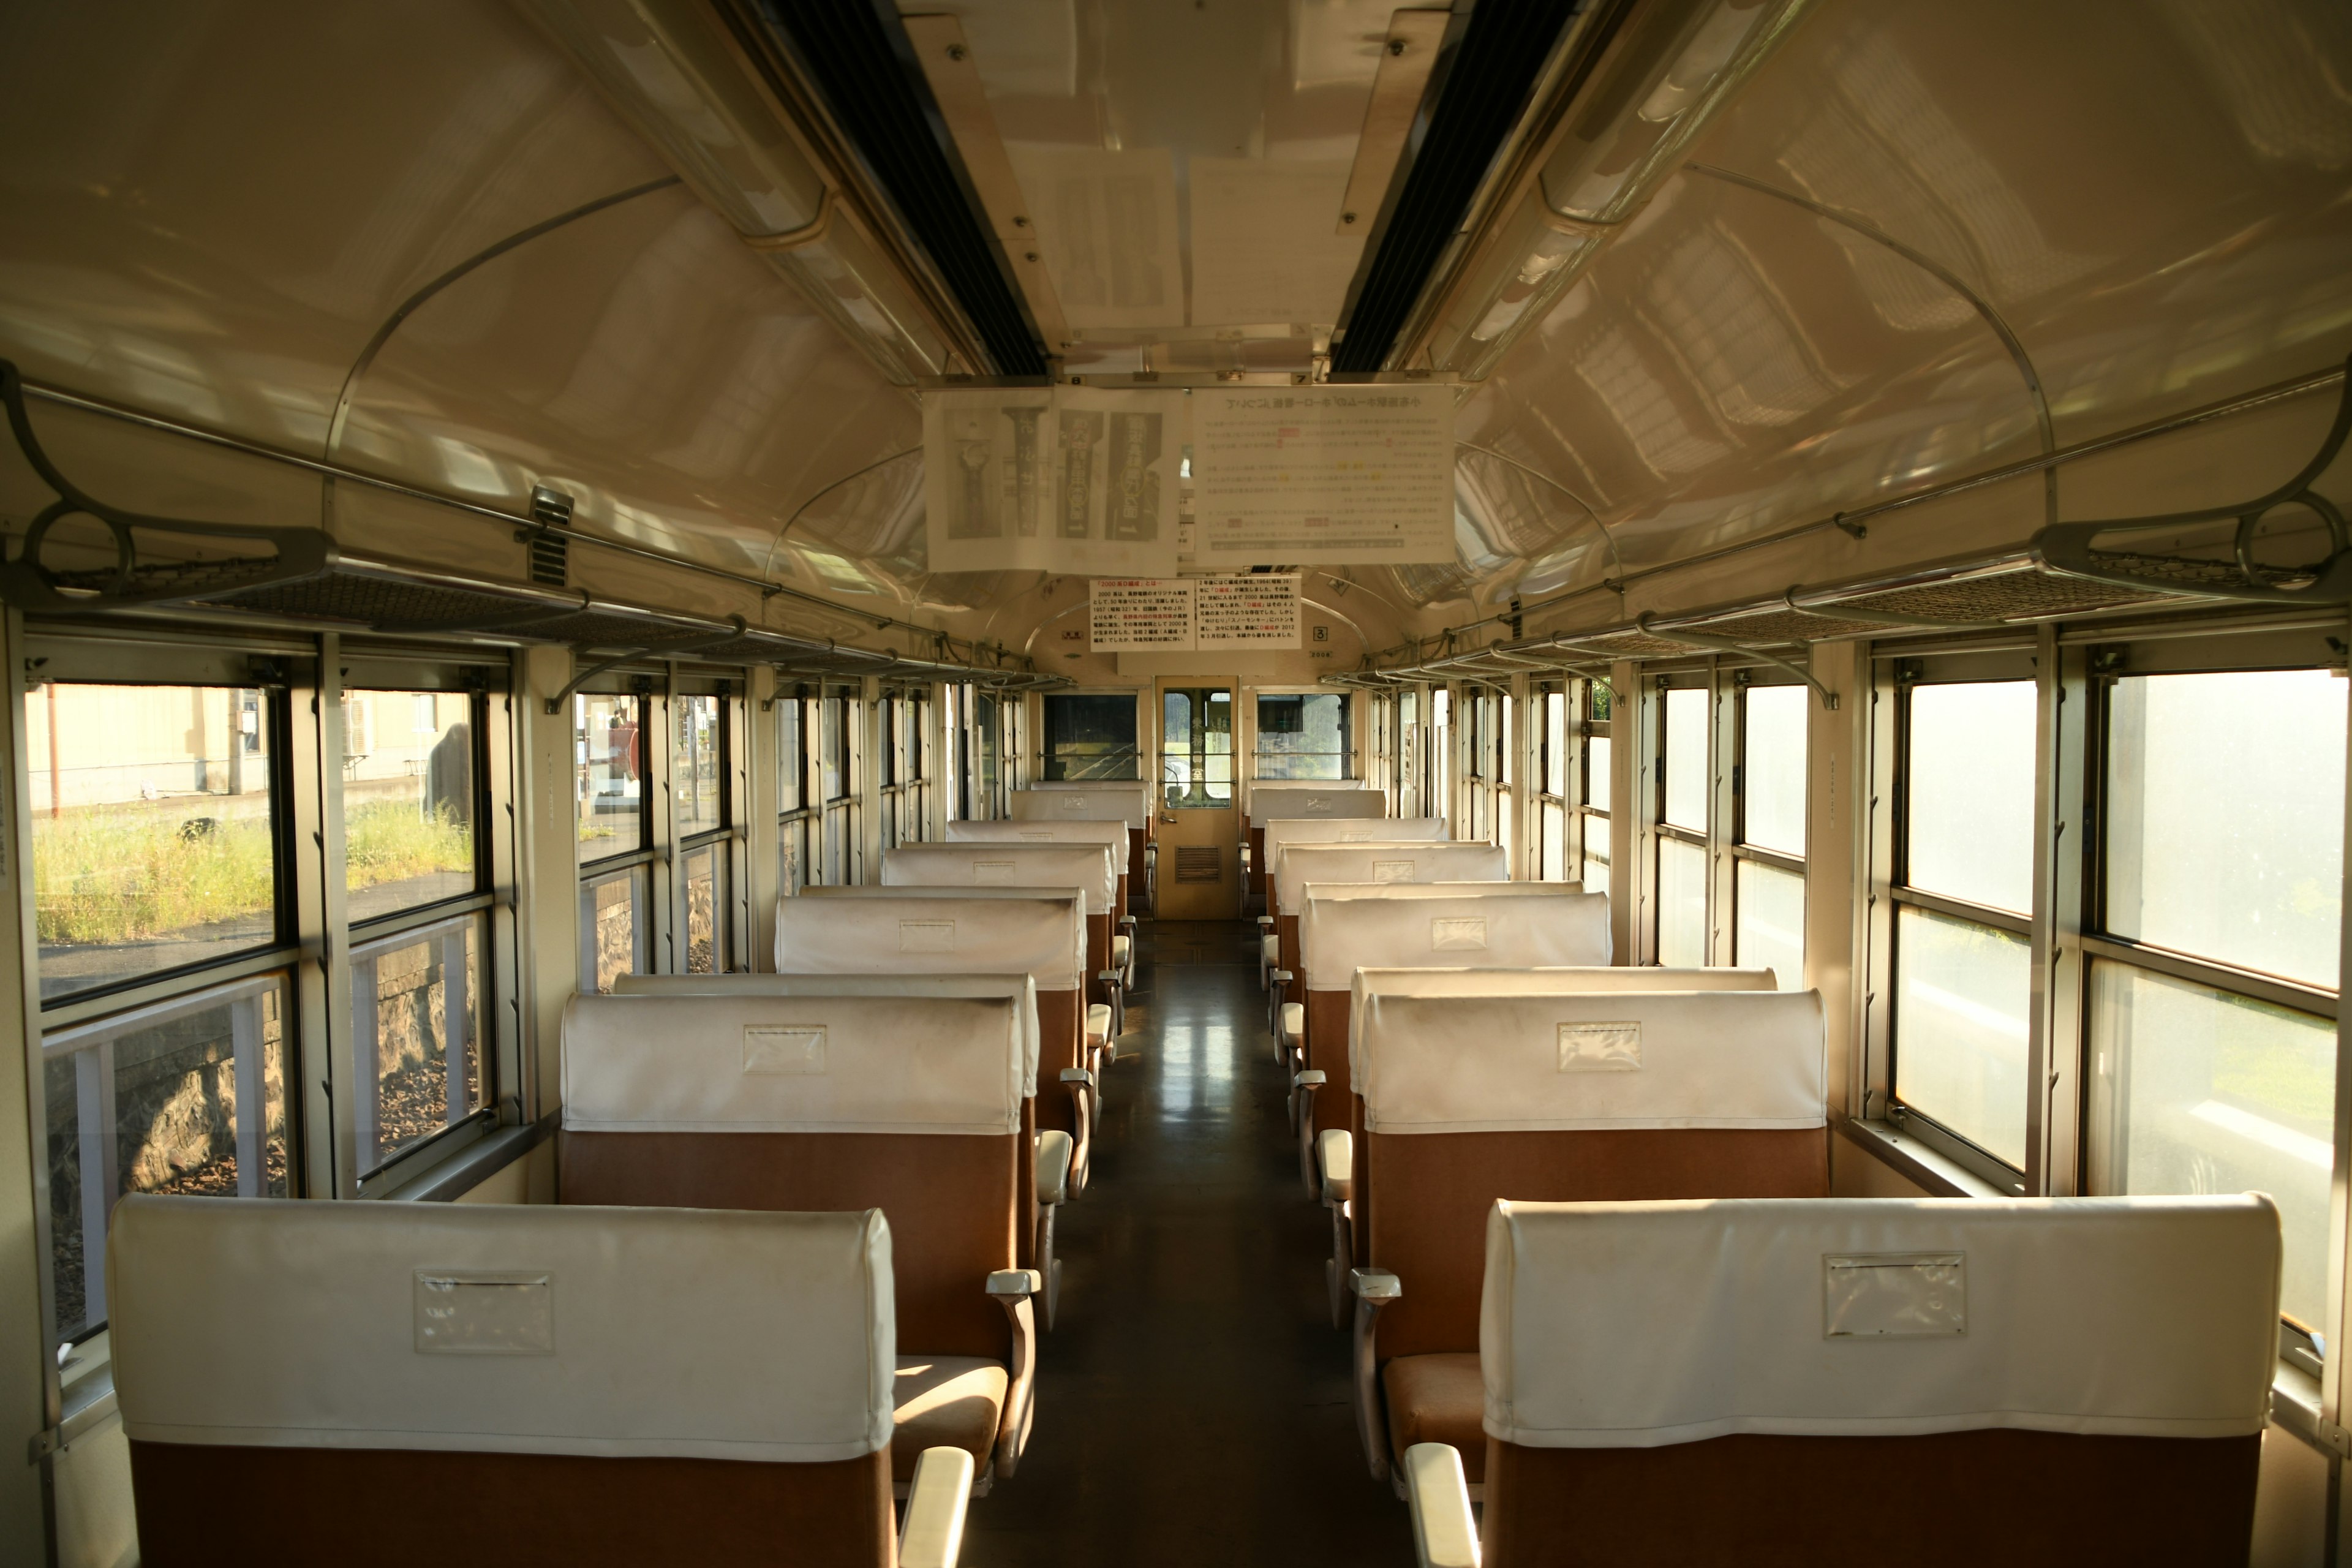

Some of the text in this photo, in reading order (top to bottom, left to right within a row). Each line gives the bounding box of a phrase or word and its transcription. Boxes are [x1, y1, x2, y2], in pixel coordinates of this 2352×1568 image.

[1317, 629, 1324, 639] 3
[1192, 717, 1204, 780] 乗務員室
